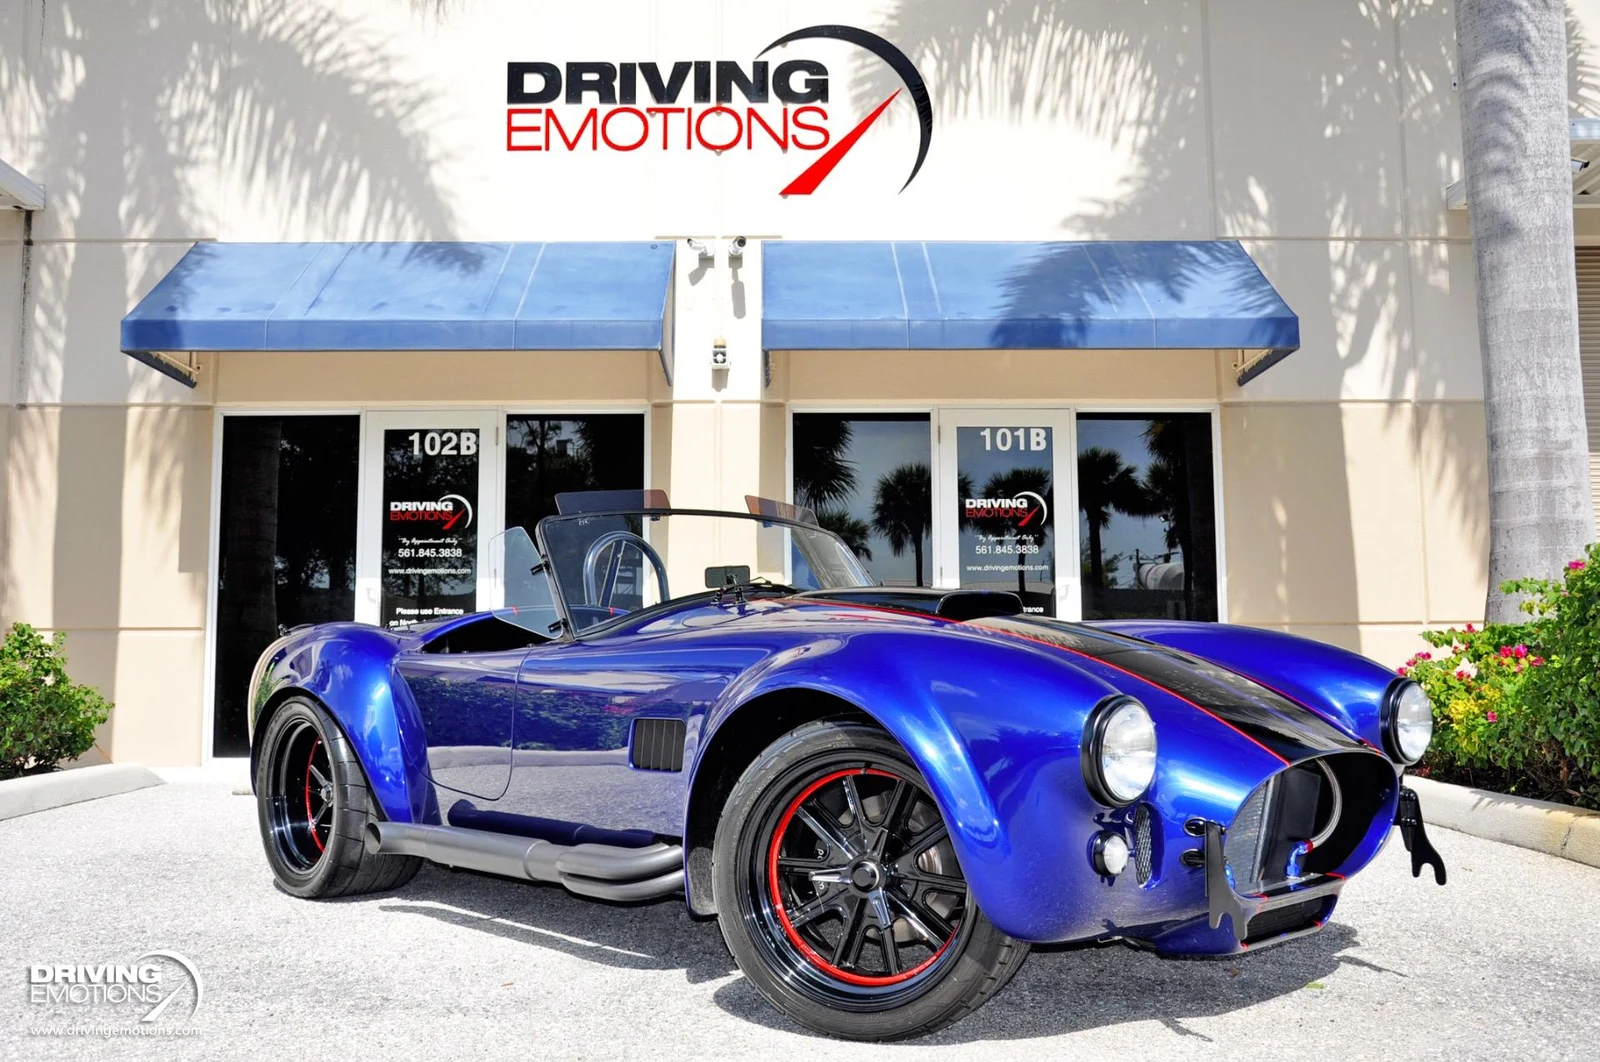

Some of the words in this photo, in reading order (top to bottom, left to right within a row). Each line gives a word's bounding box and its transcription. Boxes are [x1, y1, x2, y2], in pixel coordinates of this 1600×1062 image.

[507, 60, 829, 105] DRIVING
[507, 106, 831, 152] EMOTIONS
[408, 432, 477, 456] 102B
[980, 428, 1047, 451] 101B
[390, 501, 454, 511] DRIVING
[965, 498, 1028, 508] DRIVING
[390, 511, 453, 521] EMOTIONS
[965, 508, 1028, 518] EMOTIONS
[411, 537, 444, 545] Appointment
[987, 534, 1021, 542] Appointment
[398, 548, 463, 558] 561.845.3838
[975, 545, 1040, 555] 561.845.3838
[388, 567, 472, 576] www.drivingemotions.com
[966, 564, 1049, 573] www.drivingemotions.com
[396, 607, 419, 615] Please
[434, 607, 464, 615] Entrance
